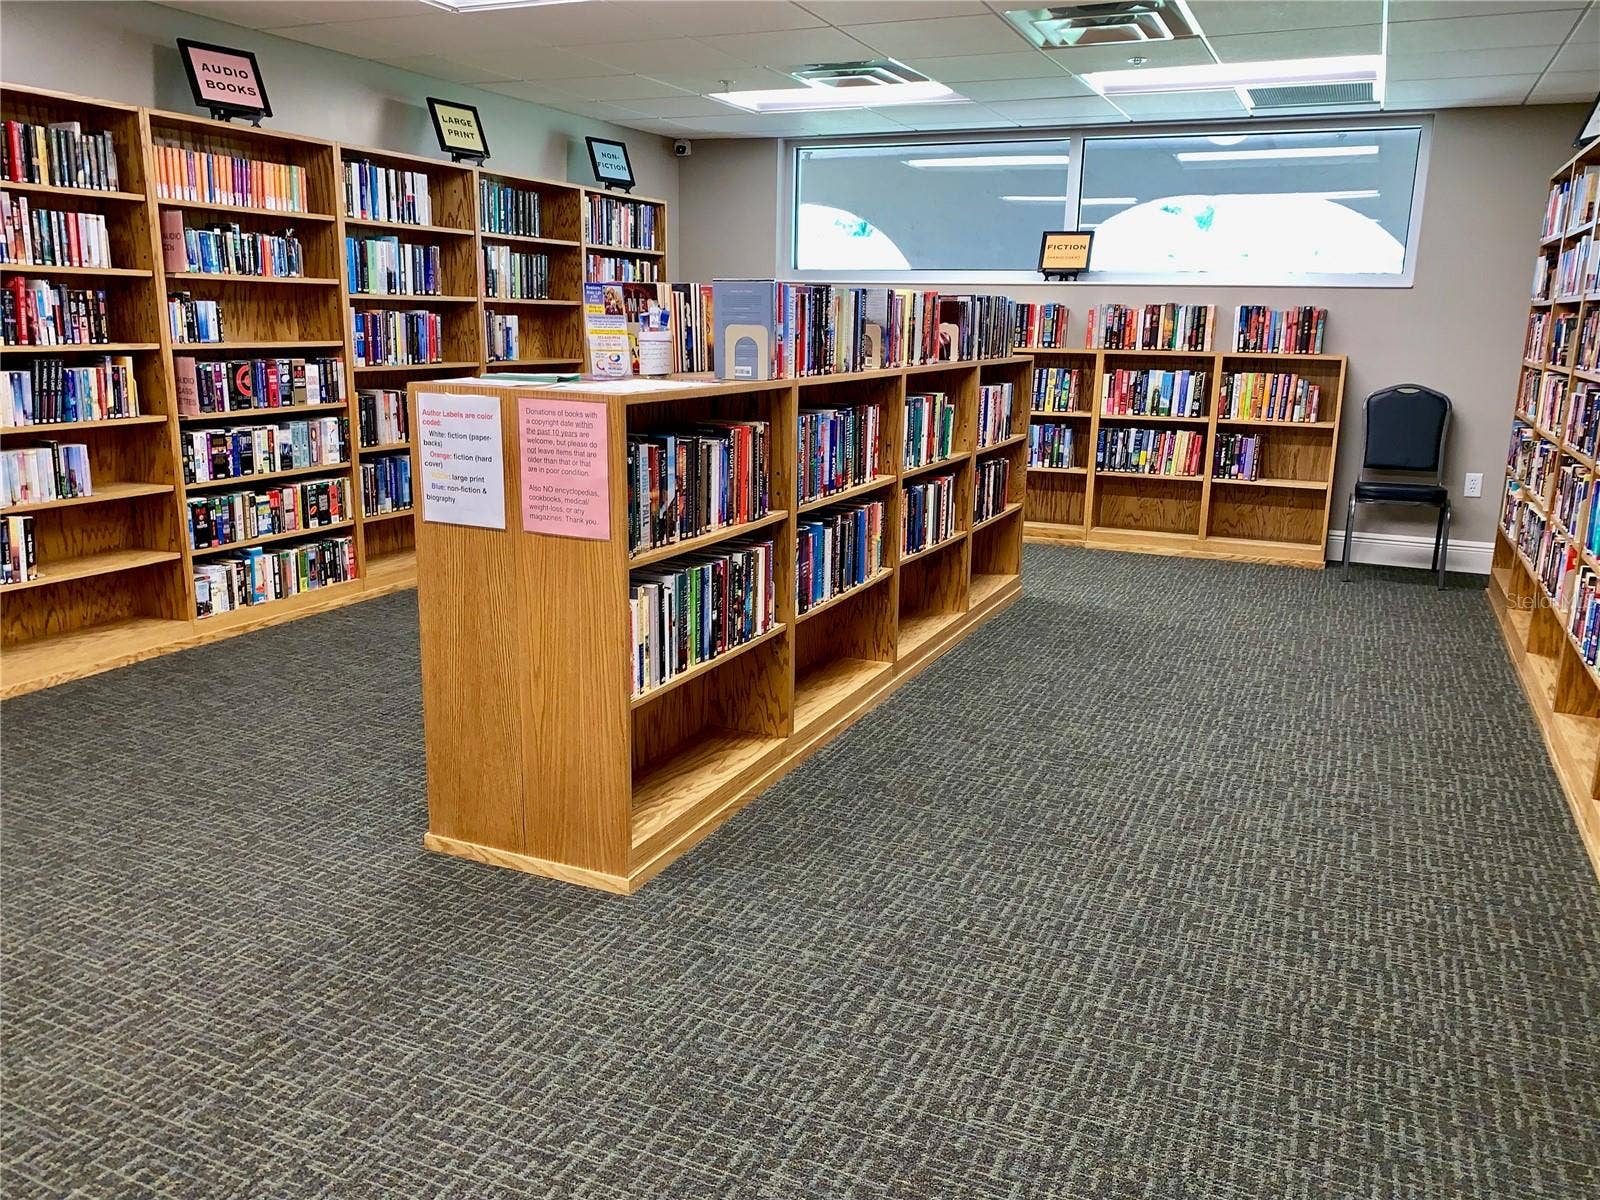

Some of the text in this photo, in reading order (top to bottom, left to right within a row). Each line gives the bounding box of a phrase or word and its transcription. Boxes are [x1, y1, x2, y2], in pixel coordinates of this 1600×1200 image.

[202, 63, 248, 79] AUDIO
[206, 80, 256, 96] BOOKS
[441, 115, 472, 128] LARGE
[447, 129, 475, 140] PRINT
[601, 152, 620, 160] NON-
[597, 161, 627, 171] FICTION
[422, 409, 441, 417] Author
[526, 408, 556, 416] Donations
[531, 419, 559, 427] copyright
[575, 421, 594, 429] within
[429, 430, 492, 441] White: fiction (paper-
[423, 440, 443, 448] backs)
[527, 438, 555, 446] welcome,
[538, 447, 554, 455] leave
[454, 453, 473, 461] fiction
[475, 455, 493, 463] (hard
[452, 474, 468, 482] large
[470, 475, 485, 483] print
[431, 482, 446, 490] Blue:
[447, 485, 481, 494] non-fiction
[529, 484, 541, 492] Also
[543, 485, 553, 493] NO
[426, 493, 456, 504] biography
[574, 508, 585, 516] any
[566, 516, 583, 524] Thank
